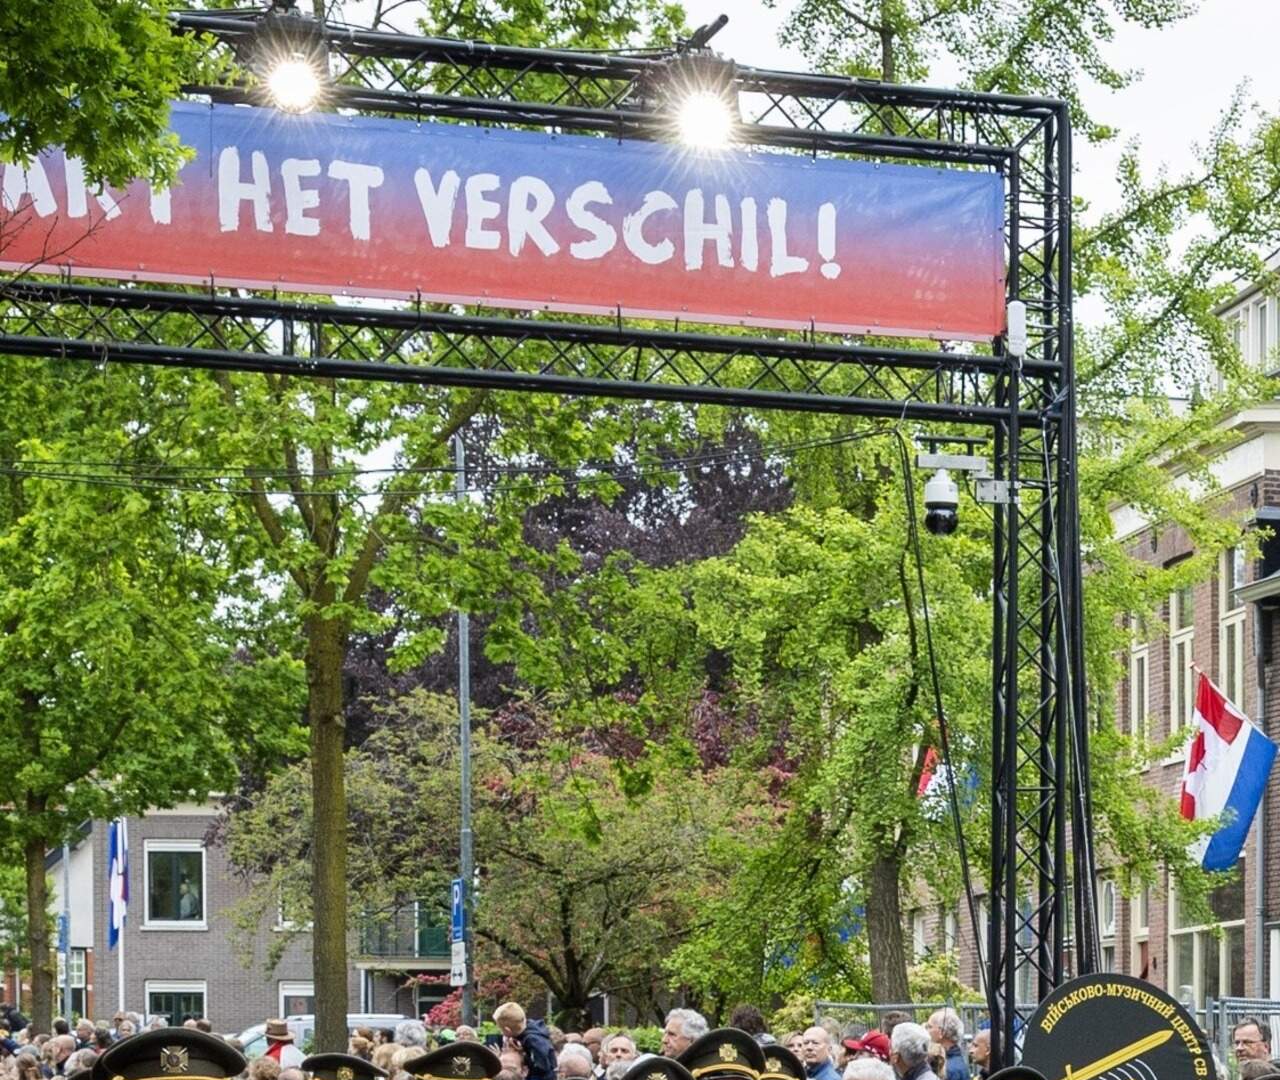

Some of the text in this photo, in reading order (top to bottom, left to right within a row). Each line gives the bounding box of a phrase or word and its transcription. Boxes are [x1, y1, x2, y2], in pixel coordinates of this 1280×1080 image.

[218, 145, 385, 241] HET
[414, 167, 842, 280] VERSCHIL!
[1040, 983, 1176, 1034] ВІЙСЬКОВО-МУЗИЧНИЙ
[1170, 1015, 1202, 1055] ЦЕНТР
[1193, 1057, 1208, 1077] СВ
